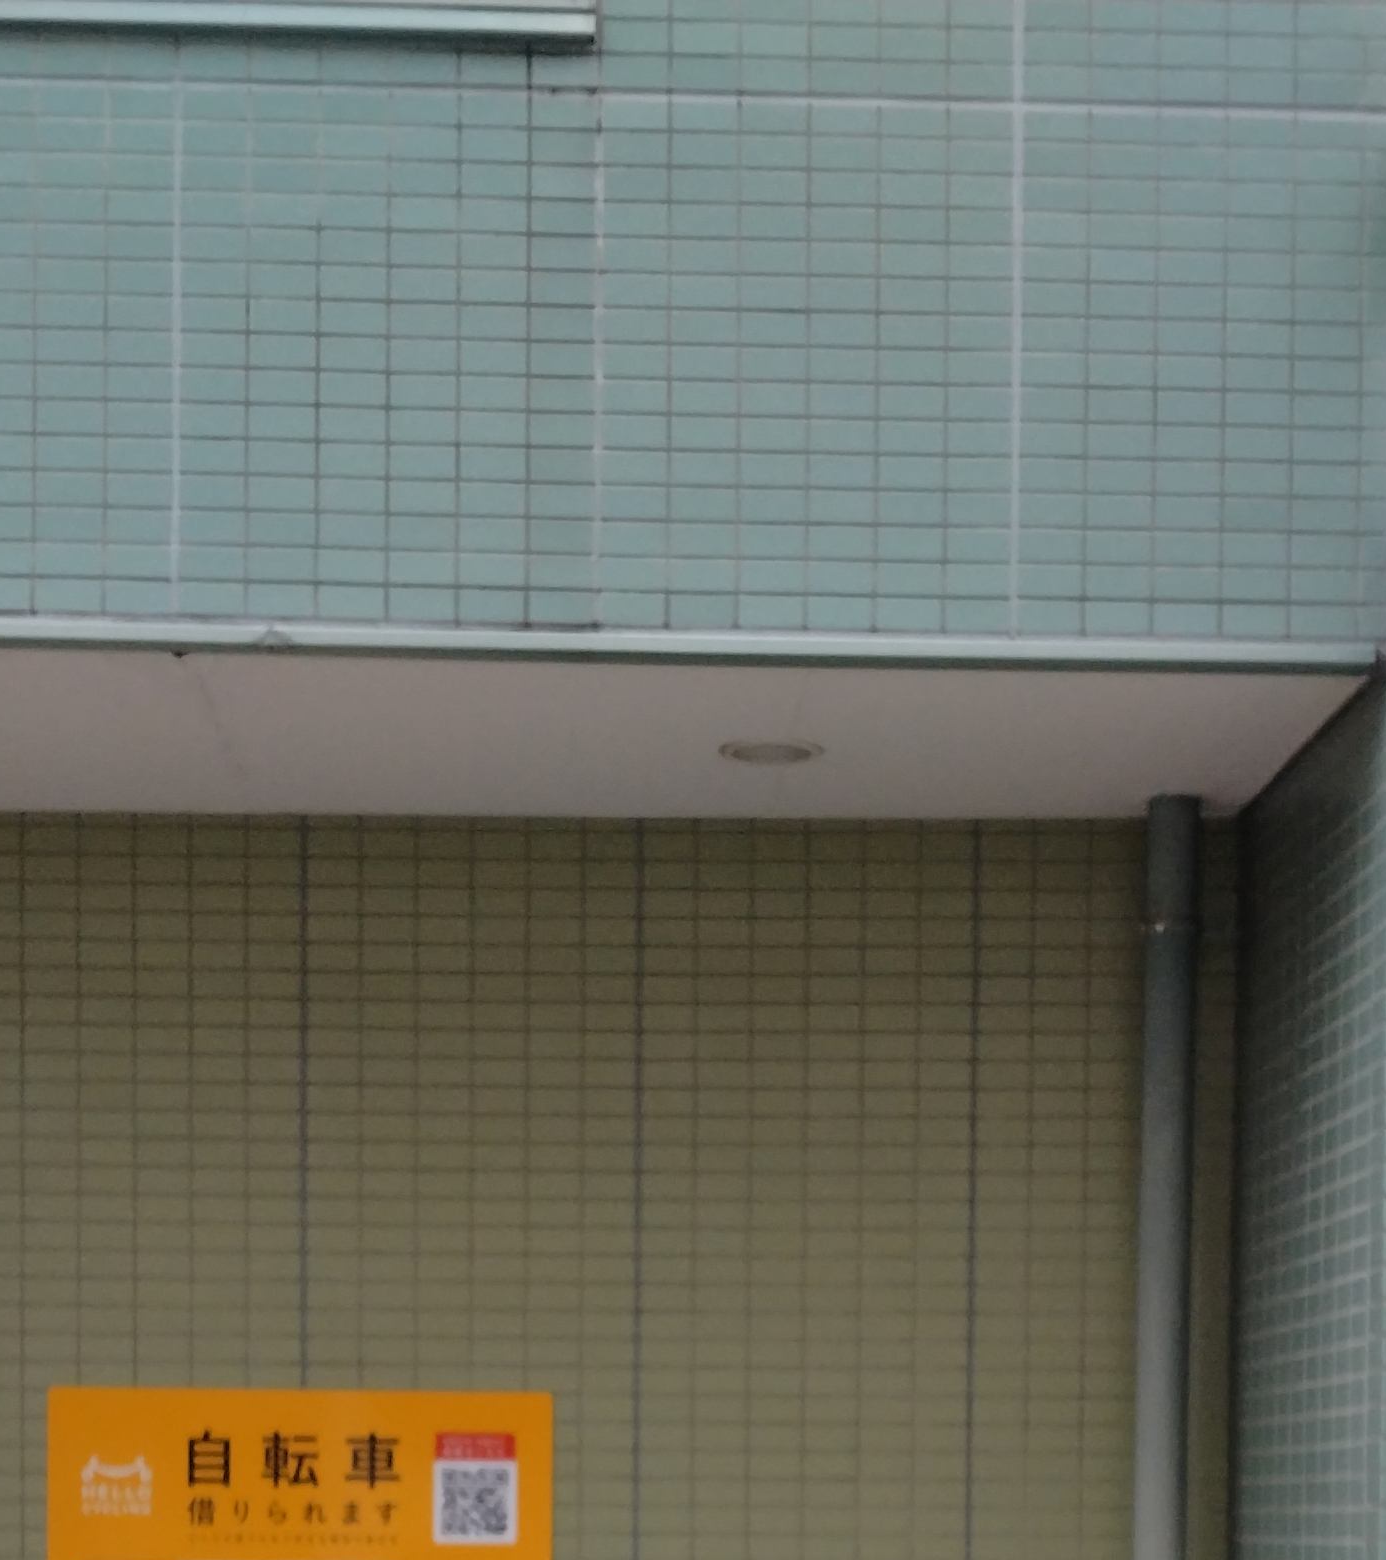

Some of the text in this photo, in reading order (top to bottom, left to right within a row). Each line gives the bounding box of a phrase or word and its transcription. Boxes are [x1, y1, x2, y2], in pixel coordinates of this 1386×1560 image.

[187, 1430, 401, 1489] 自転車
[188, 1496, 397, 1526] 借りられます
